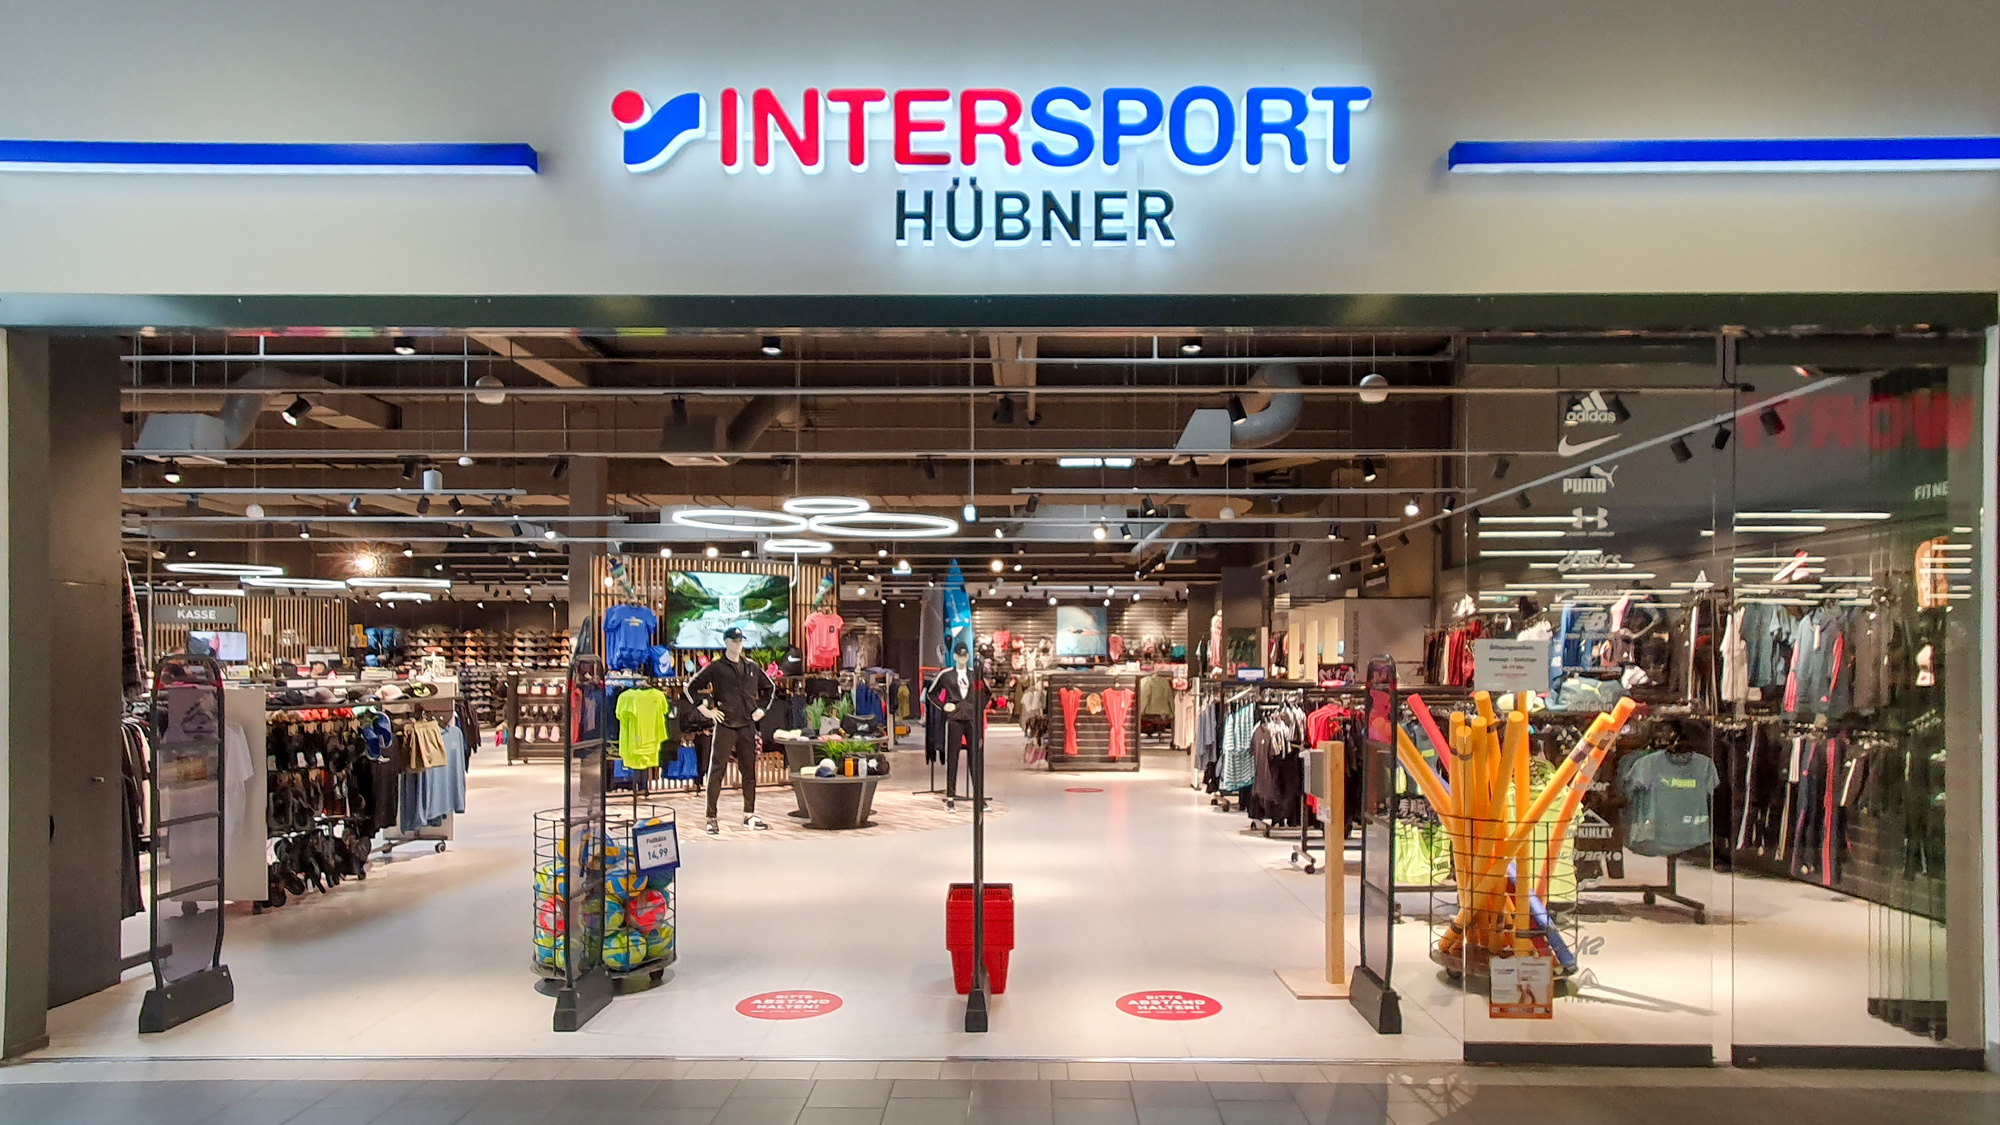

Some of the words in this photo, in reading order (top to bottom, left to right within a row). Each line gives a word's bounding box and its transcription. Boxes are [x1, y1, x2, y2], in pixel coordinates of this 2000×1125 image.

[721, 85, 1373, 168] INTERSPORT
[894, 177, 1176, 242] HÜBNER
[1566, 410, 1616, 423] adidas
[1562, 477, 1607, 494] PUMA
[177, 609, 217, 620] KASSE
[647, 848, 669, 860] 14,99
